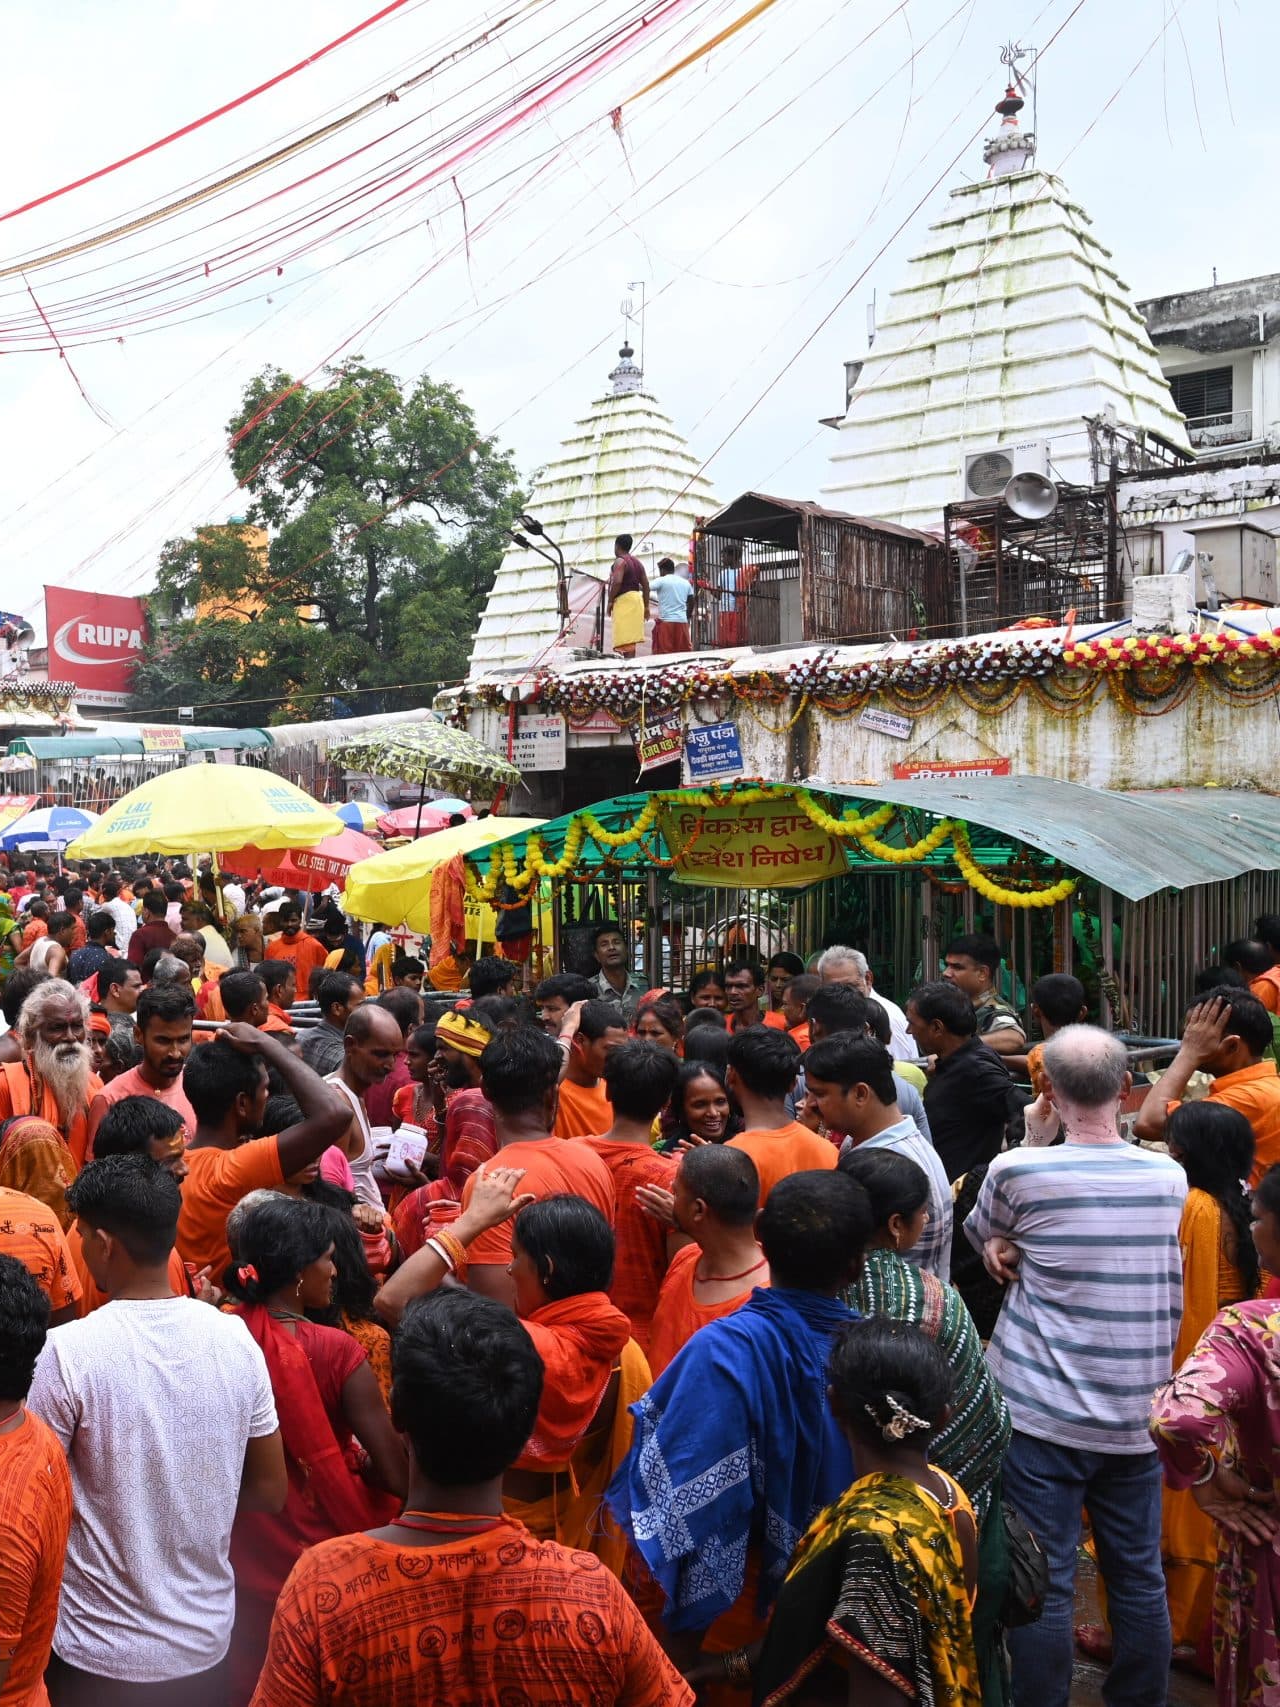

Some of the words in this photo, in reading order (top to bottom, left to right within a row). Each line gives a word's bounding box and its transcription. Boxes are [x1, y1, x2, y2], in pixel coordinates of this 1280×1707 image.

[78, 623, 143, 649] RUPA
[711, 726, 734, 740] पंडा
[125, 801, 152, 814] LALL
[271, 803, 315, 814] STEELS
[107, 817, 149, 834] STEELS
[298, 853, 308, 867] LAL
[309, 856, 326, 872] STEEL
[327, 859, 341, 875] TMT
